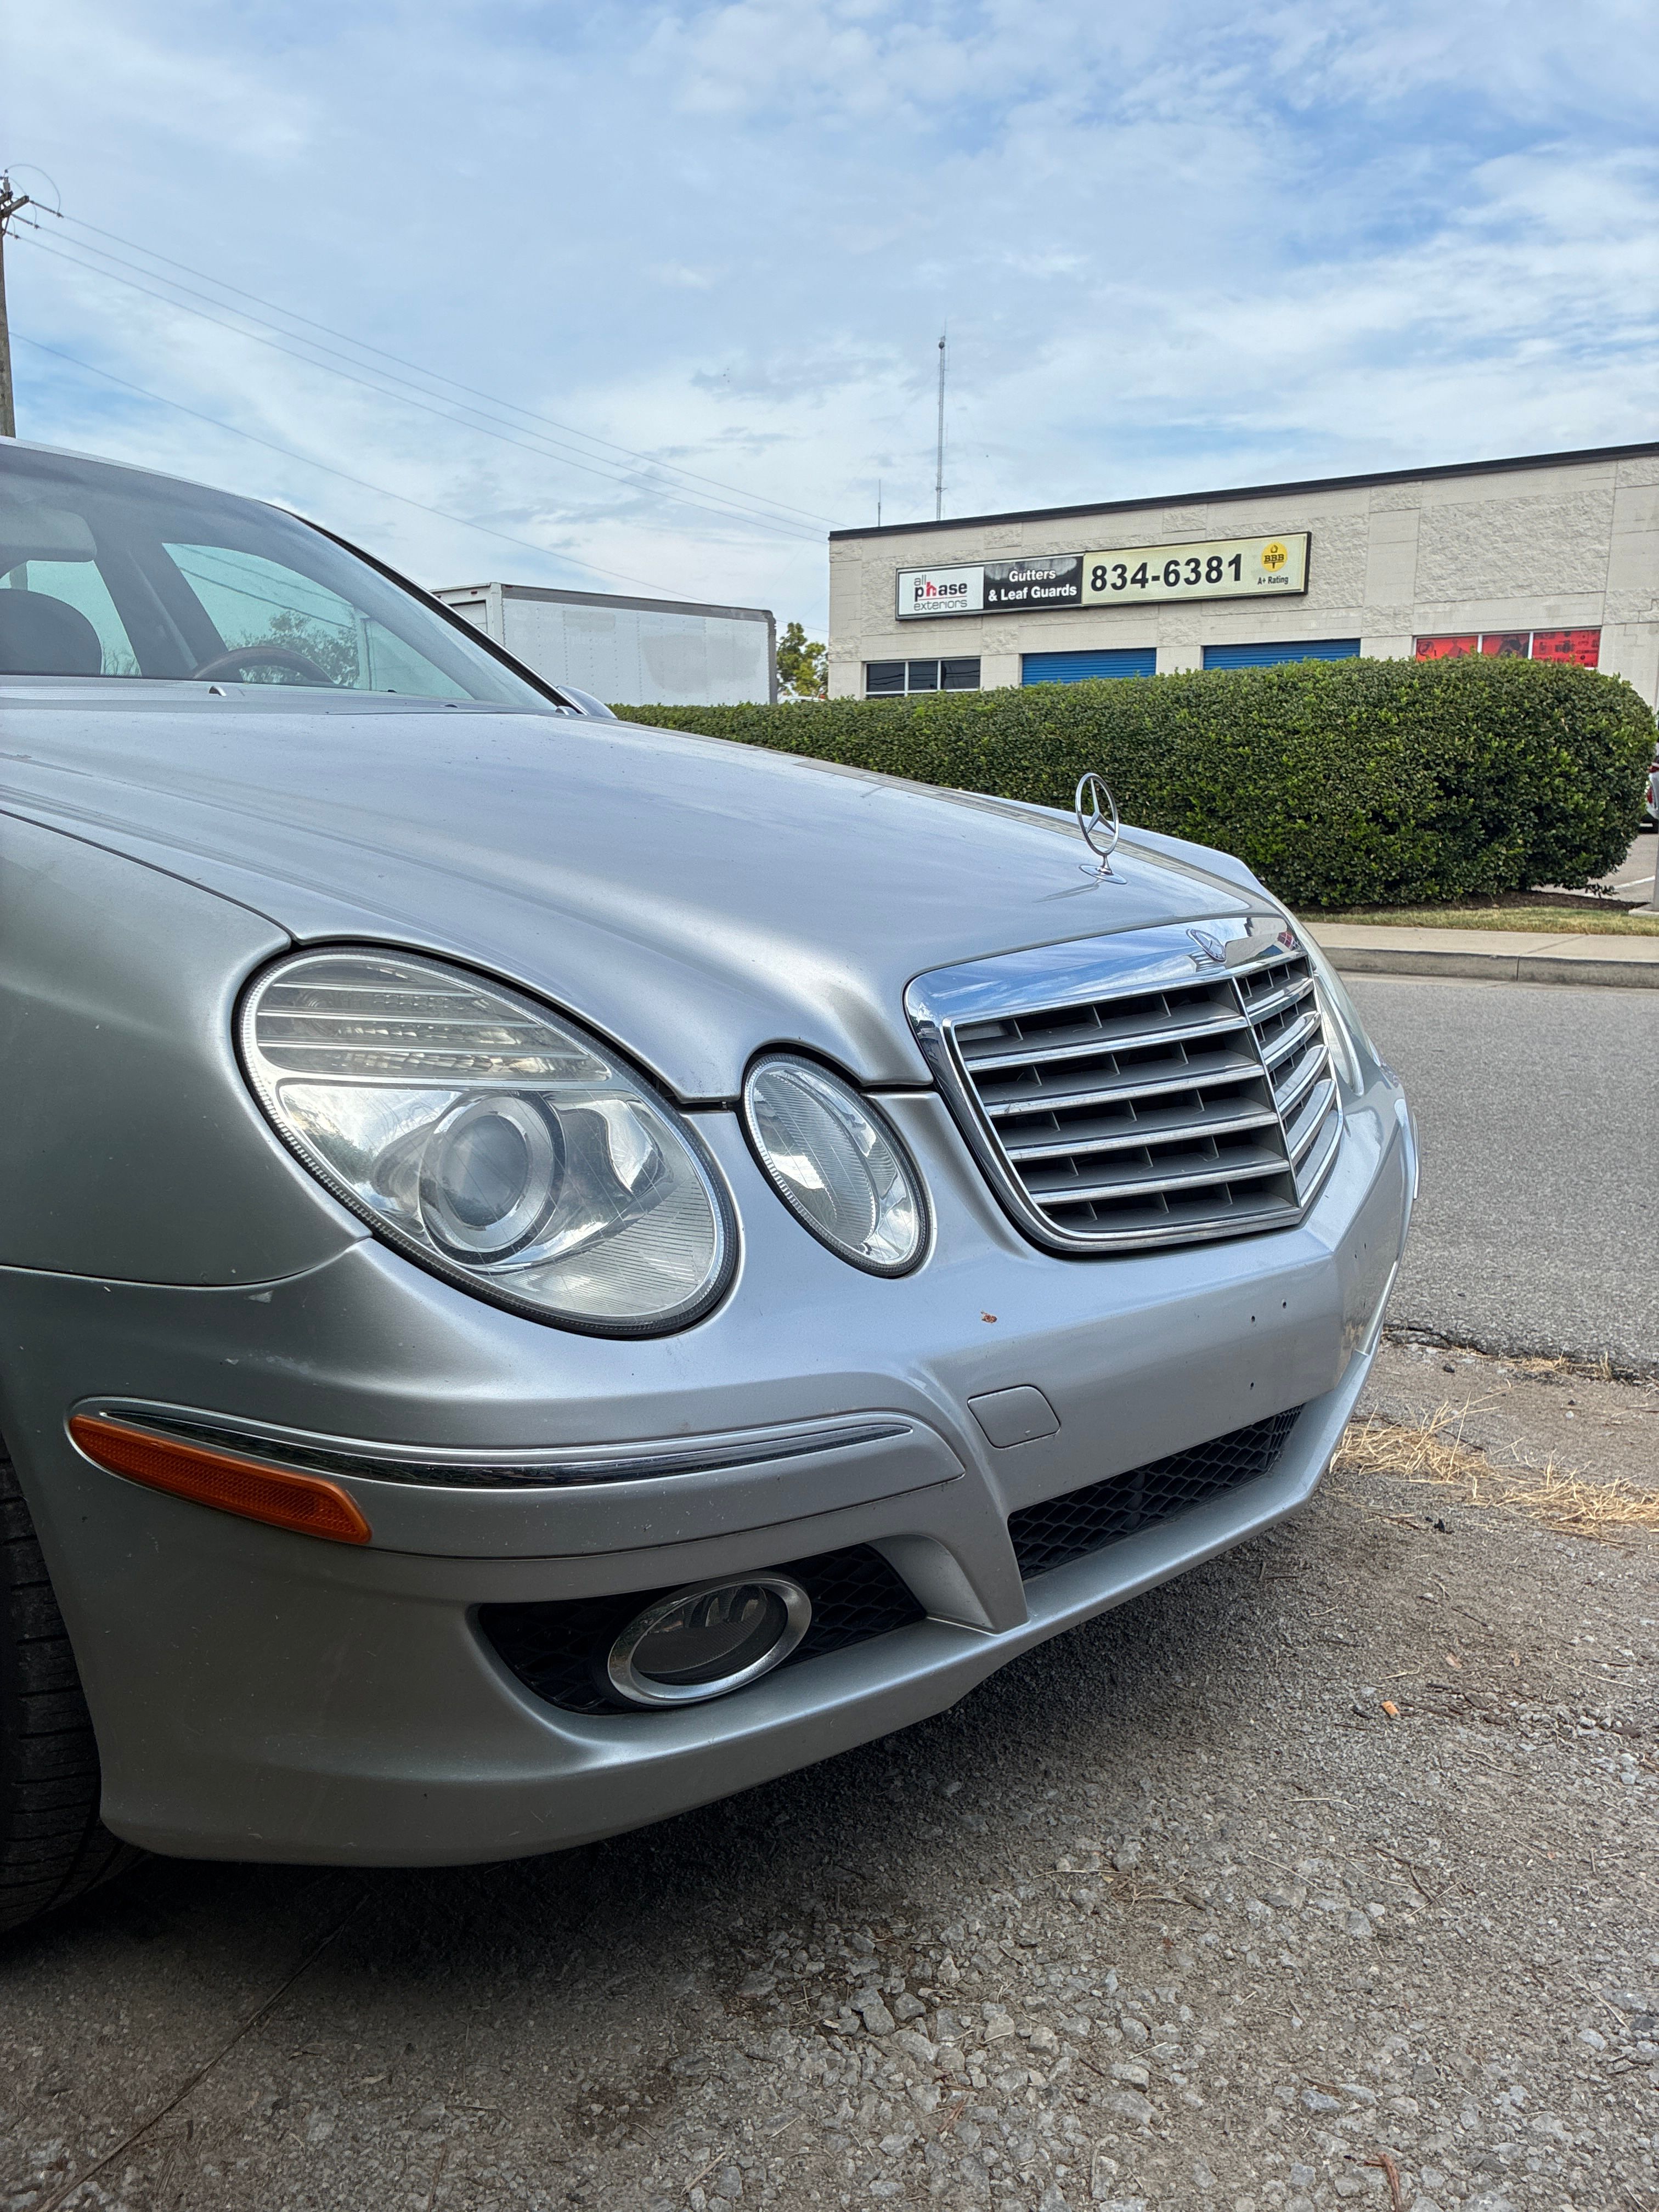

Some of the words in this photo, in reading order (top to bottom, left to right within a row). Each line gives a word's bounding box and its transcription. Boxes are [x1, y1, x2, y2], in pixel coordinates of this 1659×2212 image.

[1264, 554, 1284, 562] BBB
[1009, 569, 1056, 582] Gutters
[1091, 554, 1242, 591] 834-6381
[914, 574, 927, 586] all
[1268, 575, 1289, 585] Rating
[915, 582, 967, 602] phase
[988, 590, 998, 601] &
[1000, 588, 1028, 600] Leaf
[1030, 584, 1077, 597] Guards
[913, 600, 968, 611] exteriors
